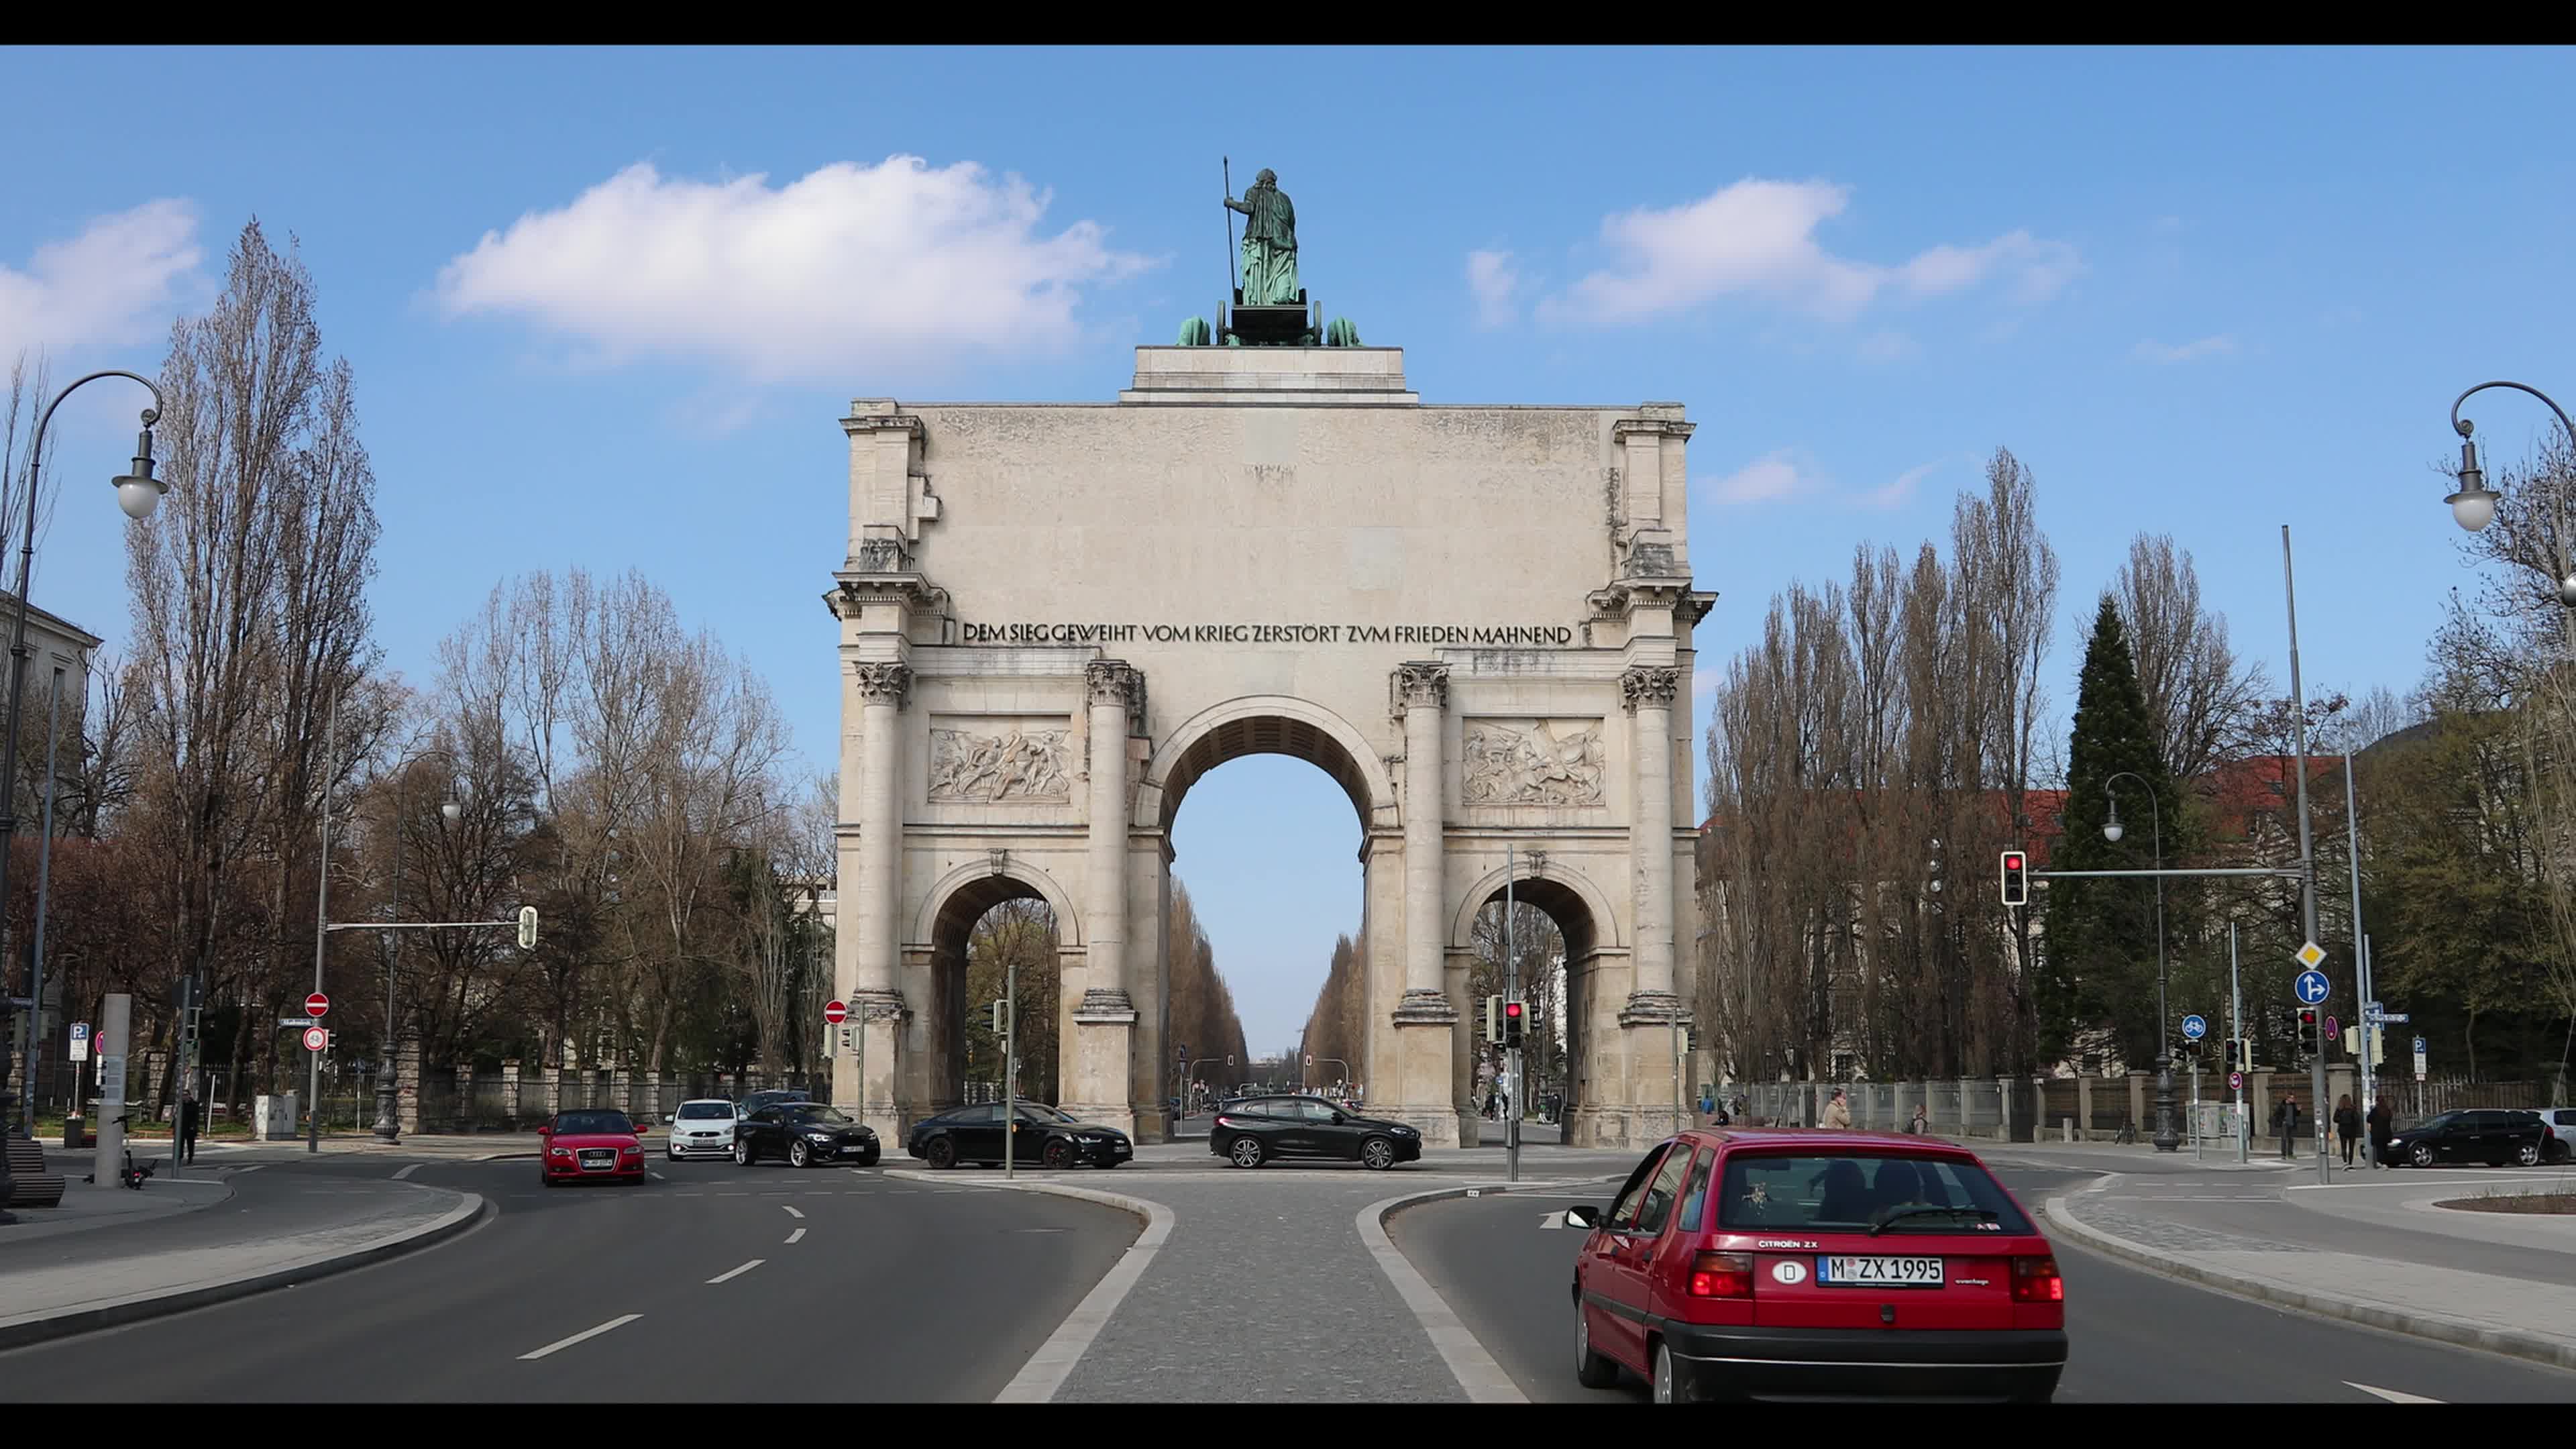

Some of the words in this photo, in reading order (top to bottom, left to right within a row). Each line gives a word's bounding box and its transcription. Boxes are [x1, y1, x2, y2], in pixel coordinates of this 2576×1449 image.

[963, 623, 1006, 642] DEM
[1010, 623, 1049, 641] SIEG
[1051, 624, 1137, 642] GEWEIHT
[1142, 625, 1190, 642] VOM
[1195, 625, 1248, 642] KRIEG
[1252, 623, 1341, 643] ZERSTÖRT
[1346, 626, 1390, 643] ZVM
[1395, 626, 1468, 643] FRIEDEN
[1473, 626, 1572, 644] MAHNEND
[73, 1026, 83, 1038] P
[1758, 1240, 1801, 1248] CITROËN
[1784, 1265, 1795, 1280] D
[1831, 1259, 1845, 1278] M
[1859, 1259, 1885, 1279] ZX
[1890, 1260, 1940, 1279] 1995
